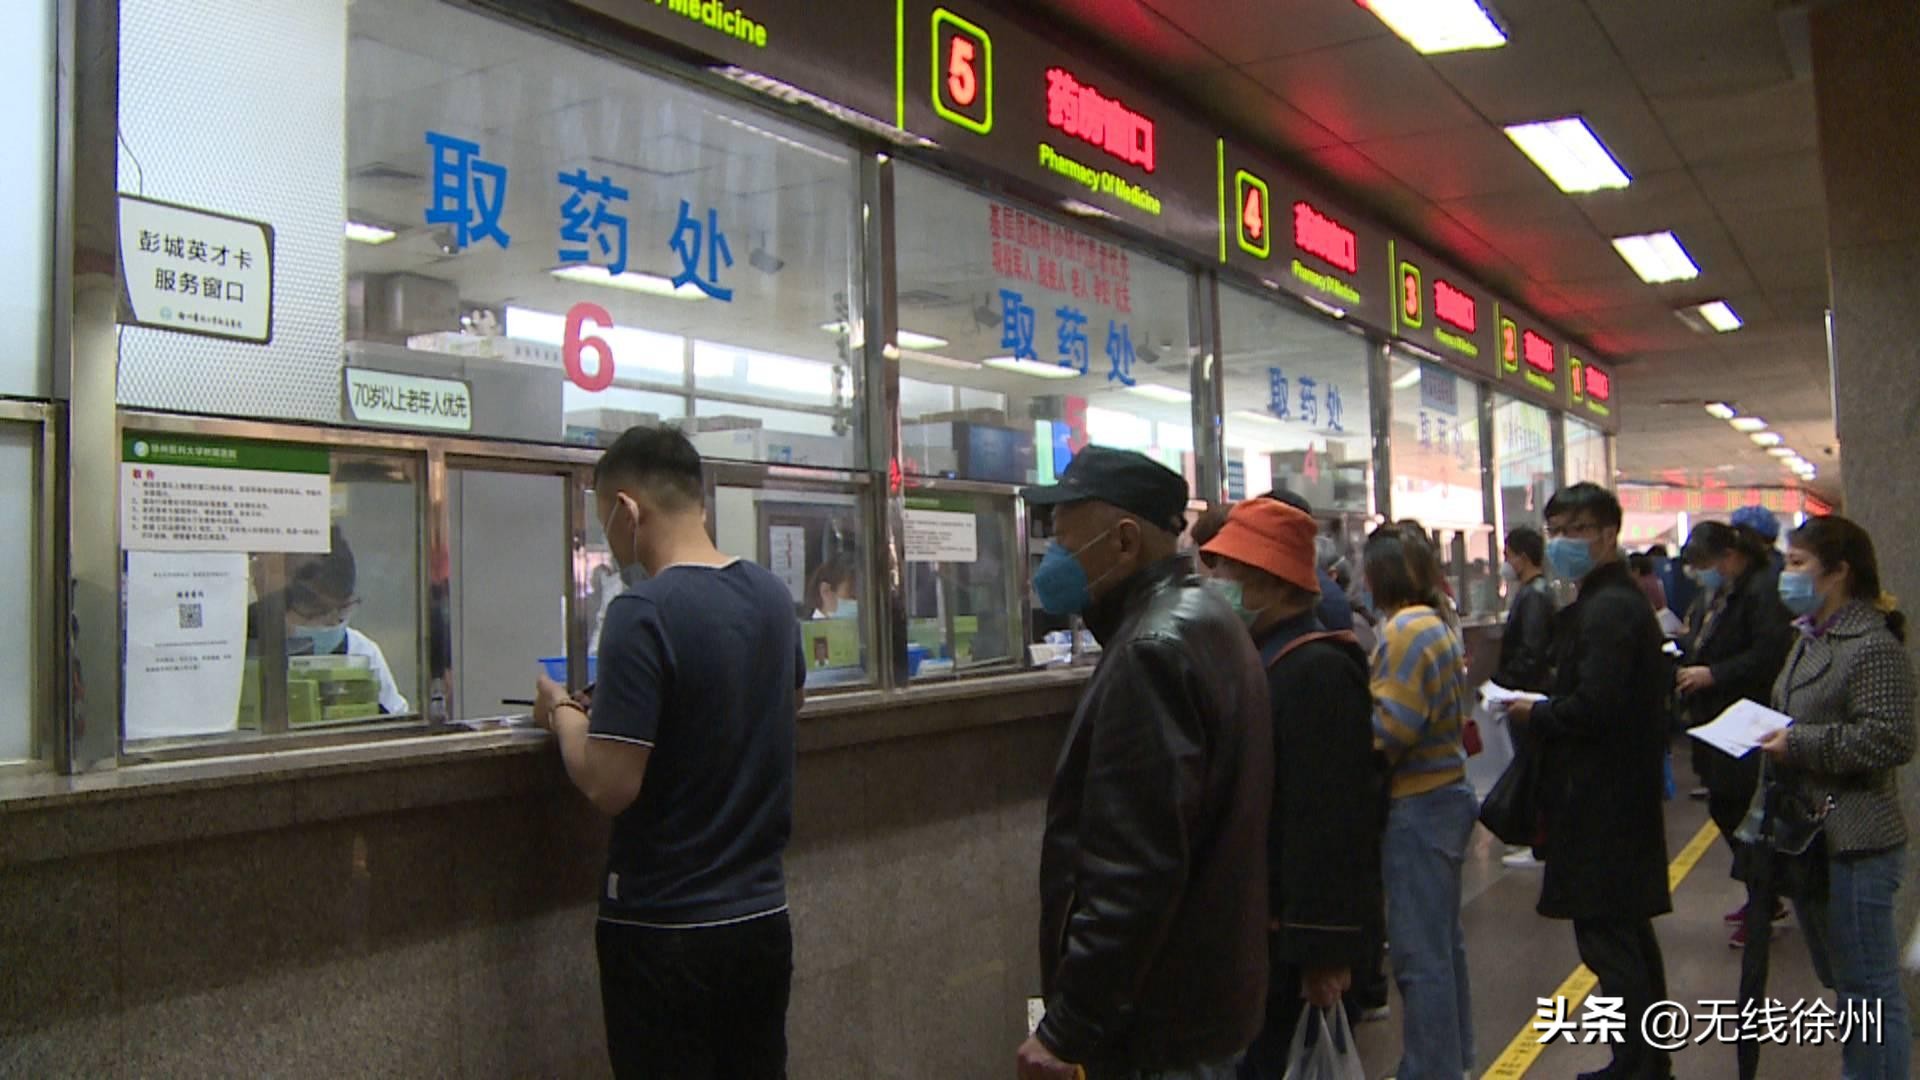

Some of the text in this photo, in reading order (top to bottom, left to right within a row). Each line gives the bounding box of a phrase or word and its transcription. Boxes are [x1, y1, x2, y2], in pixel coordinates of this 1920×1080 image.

[948, 33, 976, 106] 5
[1039, 143, 1161, 215] Pharmacy Of Medicine
[1243, 186, 1262, 239] 4
[138, 229, 253, 270] 彭城英才卡
[424, 130, 734, 302] 取药处
[154, 267, 244, 303] 服务窗口
[562, 301, 615, 392] 6
[999, 288, 1137, 386] 取药处
[352, 382, 468, 418] 70岁以上老年人优先
[1266, 366, 1344, 432] 取药处
